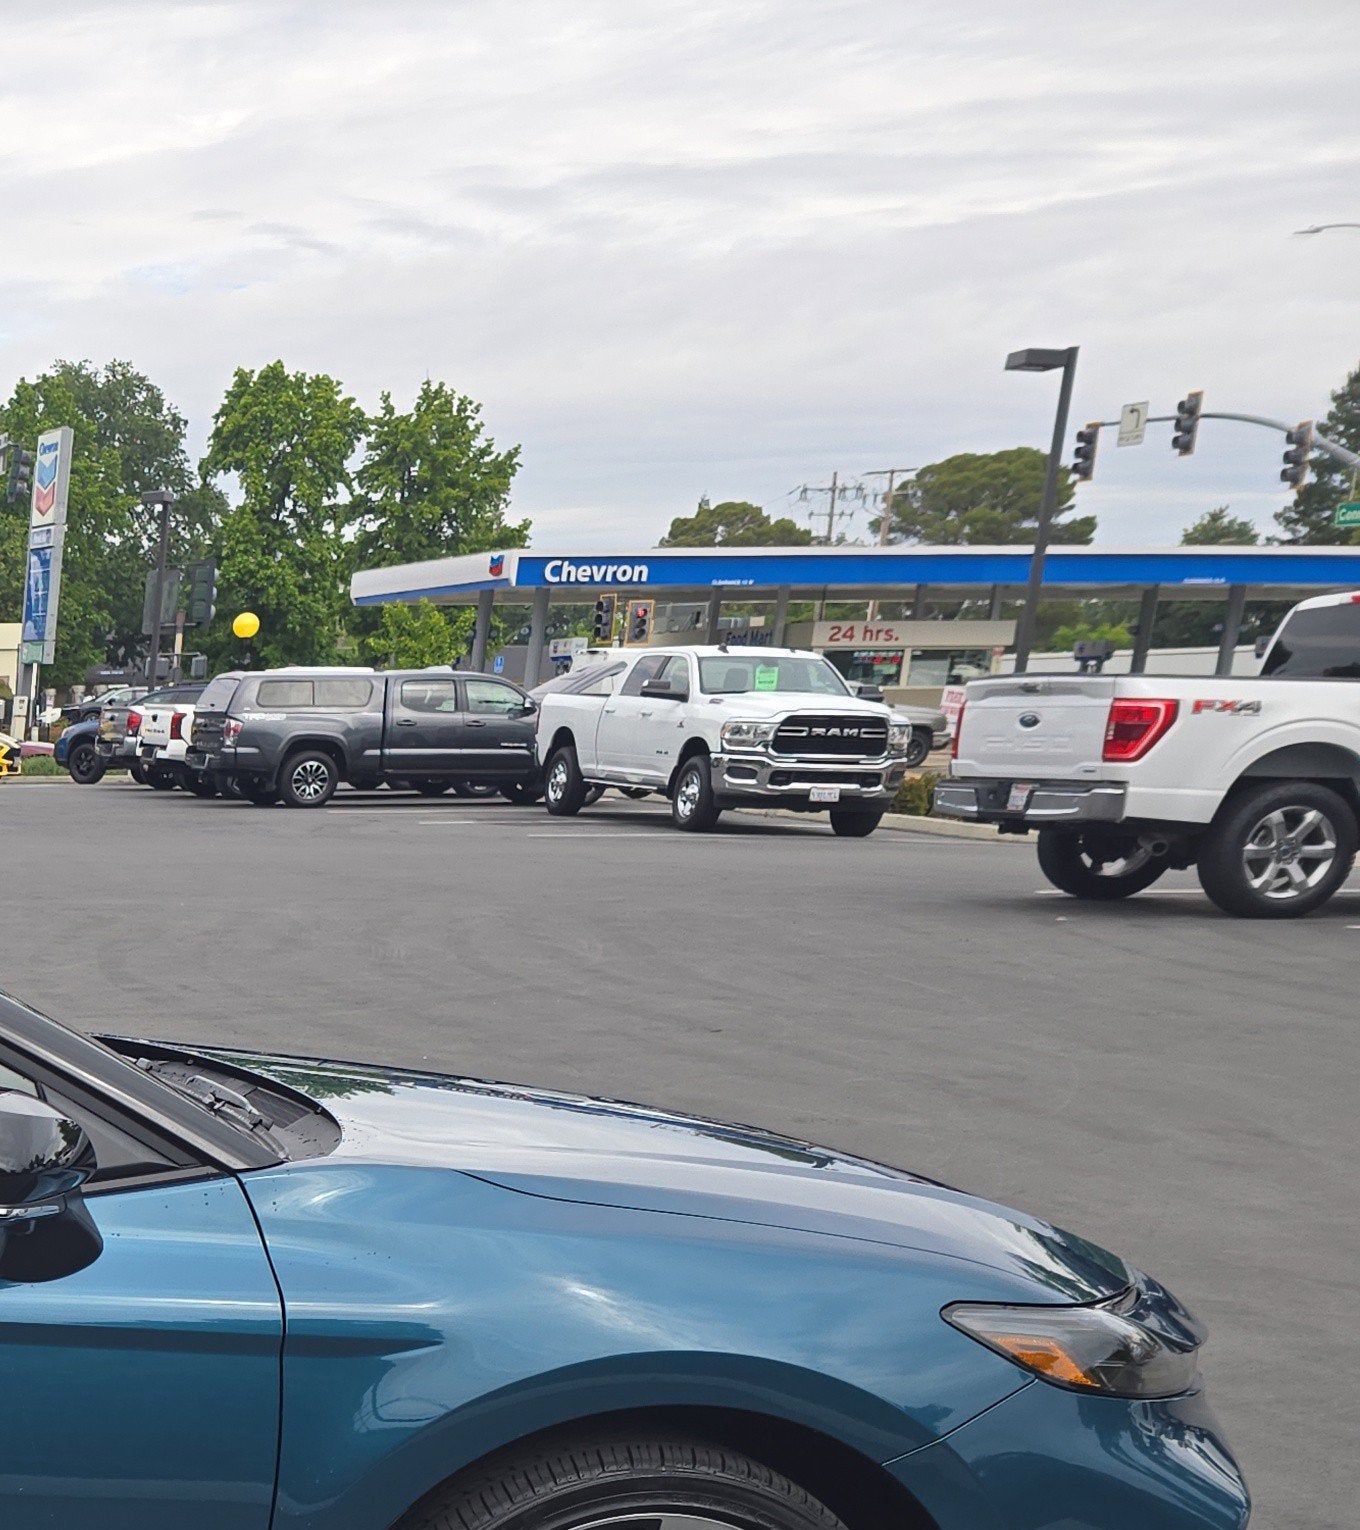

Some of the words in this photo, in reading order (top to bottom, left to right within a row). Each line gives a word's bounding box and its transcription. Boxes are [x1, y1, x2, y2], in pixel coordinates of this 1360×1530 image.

[544, 560, 649, 583] Chevron
[828, 626, 855, 642] 24
[862, 625, 899, 642] hrs.
[1191, 699, 1262, 715] FX4
[811, 727, 859, 737] RAM
